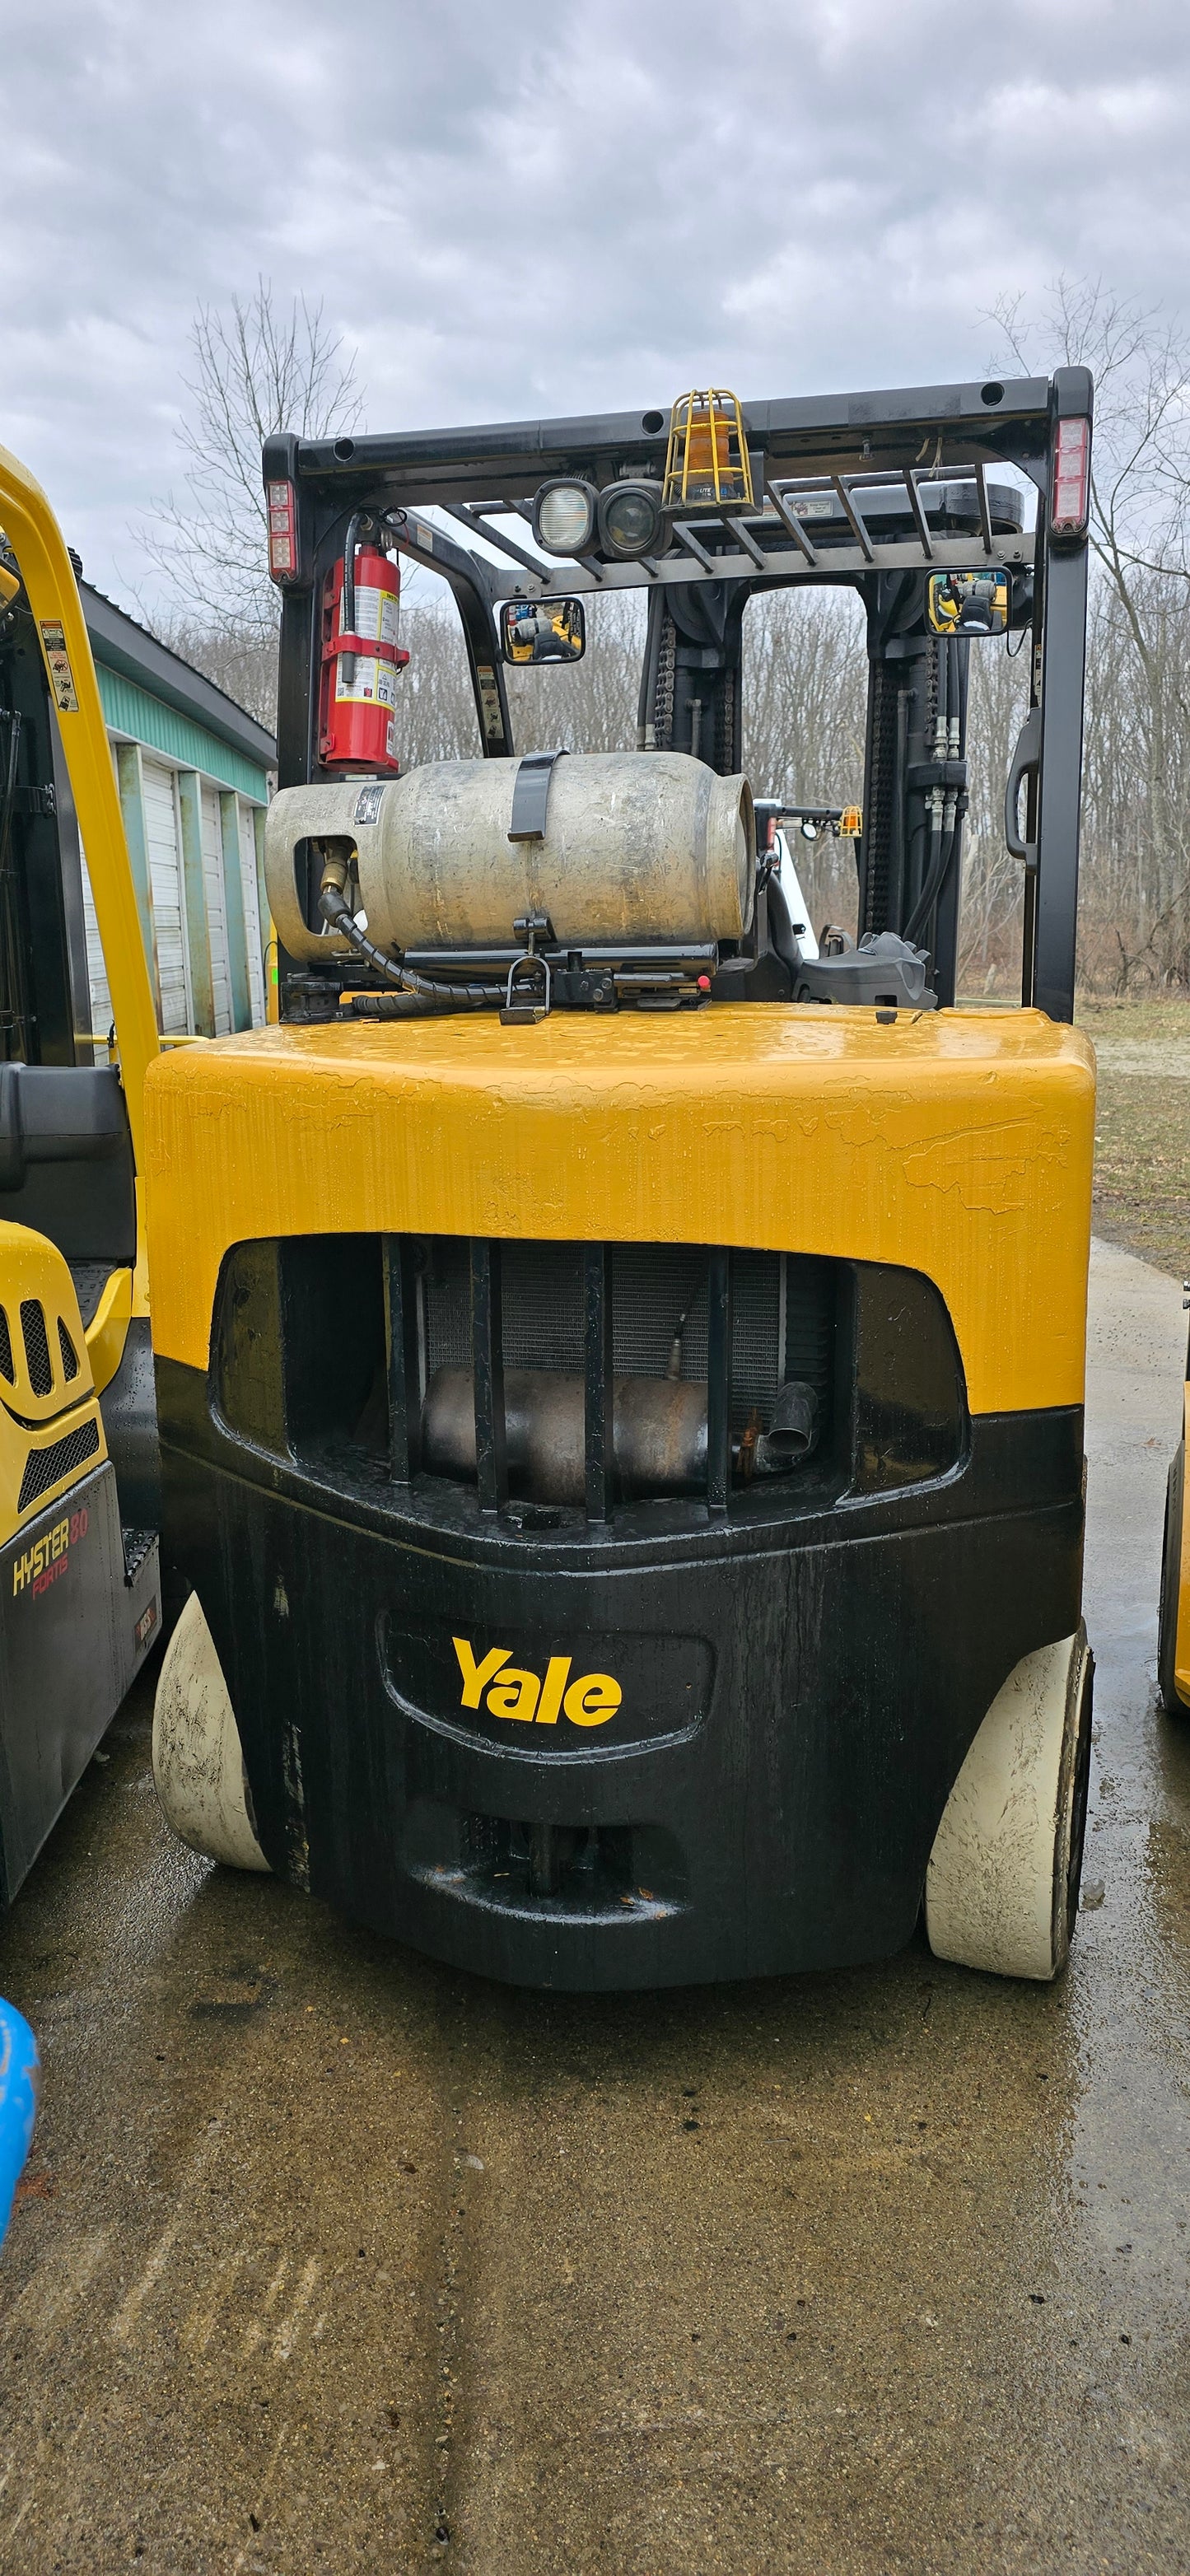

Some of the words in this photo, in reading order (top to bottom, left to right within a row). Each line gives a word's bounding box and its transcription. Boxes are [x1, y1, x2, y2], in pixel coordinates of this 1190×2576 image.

[13, 1518, 69, 1597] HYSTER
[70, 1508, 88, 1545] 80
[31, 1552, 68, 1601] FORTIS
[452, 1636, 623, 1727] Yale
